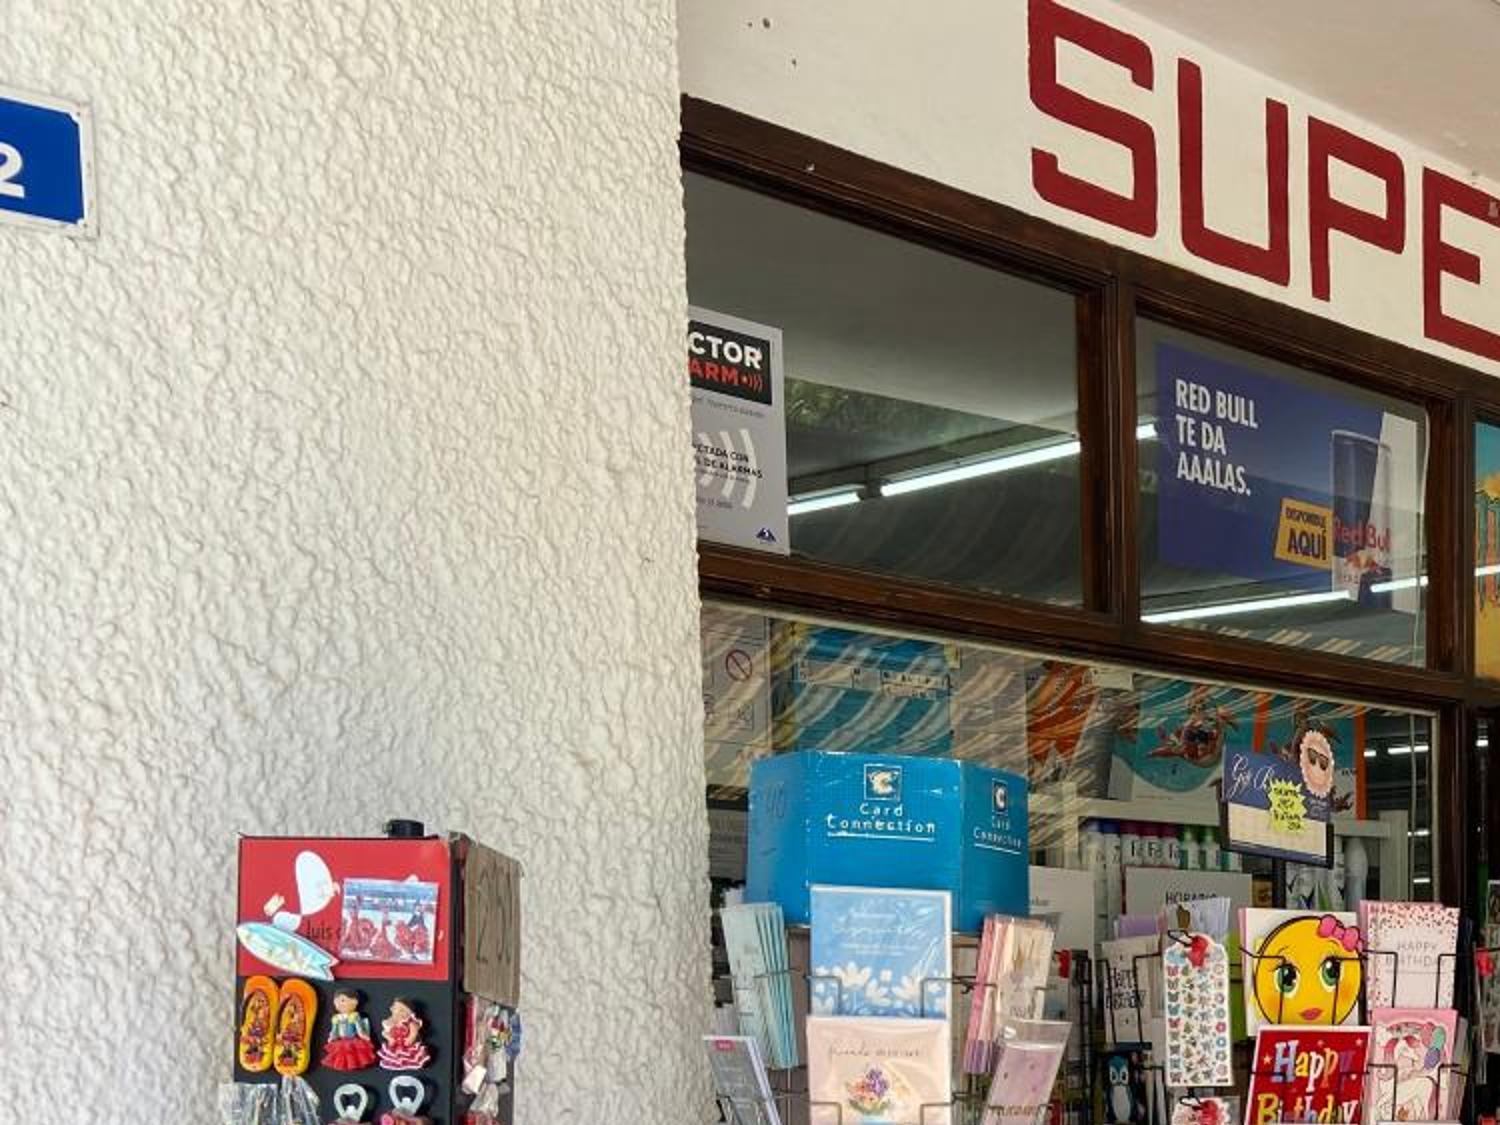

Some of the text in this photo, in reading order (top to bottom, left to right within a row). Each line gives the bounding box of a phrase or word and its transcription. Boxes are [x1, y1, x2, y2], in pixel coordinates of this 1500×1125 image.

[1176, 379, 1258, 428] RED BULL
[1176, 414, 1226, 455] TE DA
[1177, 451, 1251, 496] AAALAS.
[1287, 527, 1327, 561] AQUÍ
[826, 813, 936, 834] Connection
[859, 802, 904, 816] Card
[1270, 1039, 1356, 1094] Happy
